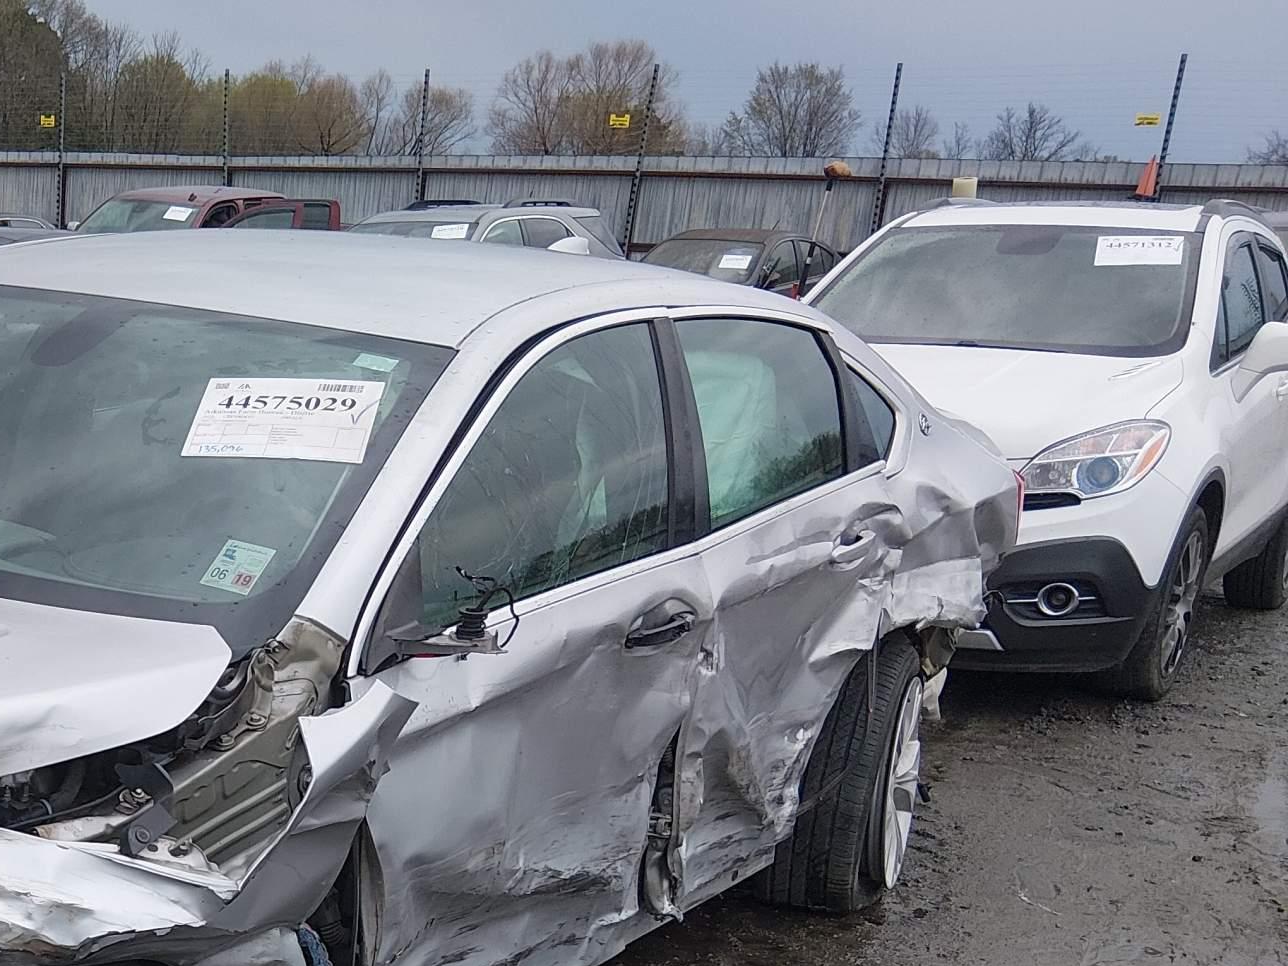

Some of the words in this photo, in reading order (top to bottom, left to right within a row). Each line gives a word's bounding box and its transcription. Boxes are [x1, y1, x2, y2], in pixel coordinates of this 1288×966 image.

[217, 395, 358, 412] 44575029
[210, 567, 230, 580] 06
[234, 574, 253, 586] 19
